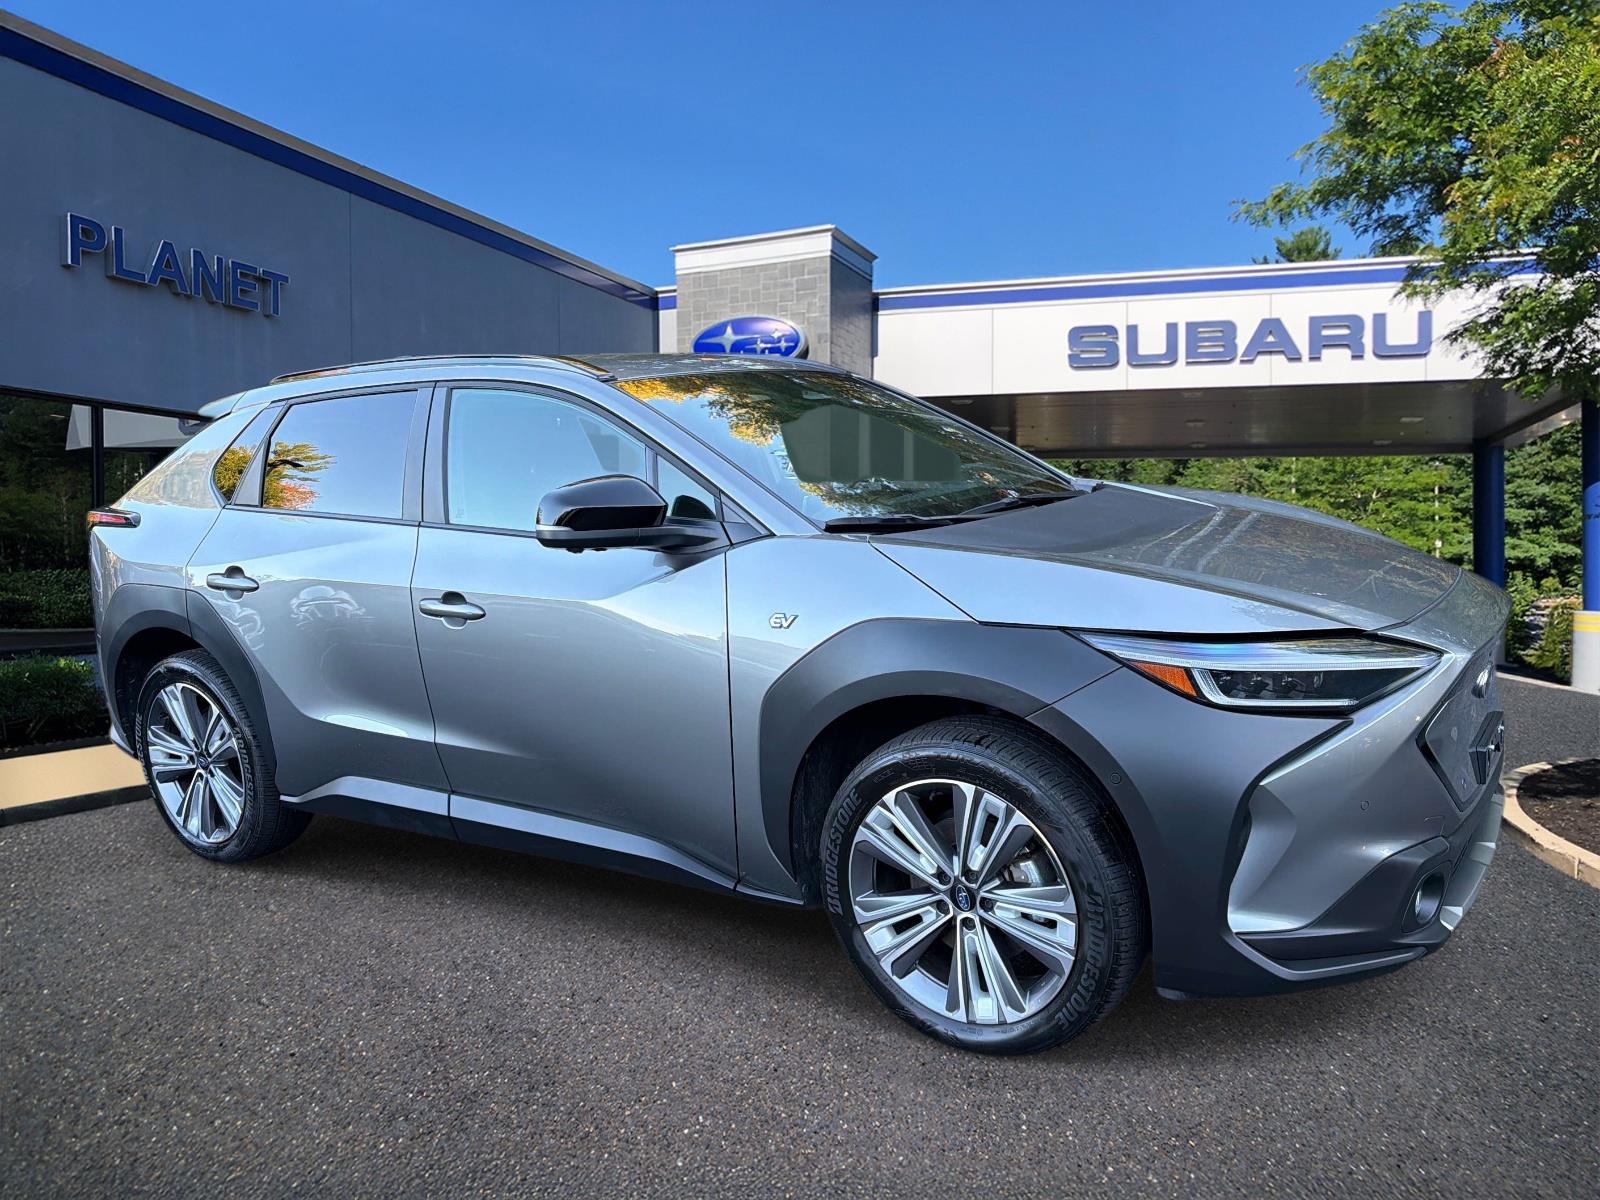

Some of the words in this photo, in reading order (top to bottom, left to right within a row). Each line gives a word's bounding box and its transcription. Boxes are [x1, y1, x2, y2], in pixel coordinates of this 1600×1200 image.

[66, 211, 290, 317] PLANET
[1067, 310, 1432, 369] SUBARU
[768, 612, 799, 629] EV
[825, 788, 863, 916] BRIDGESTONE
[1055, 894, 1105, 1031] BRIDGESTONE
